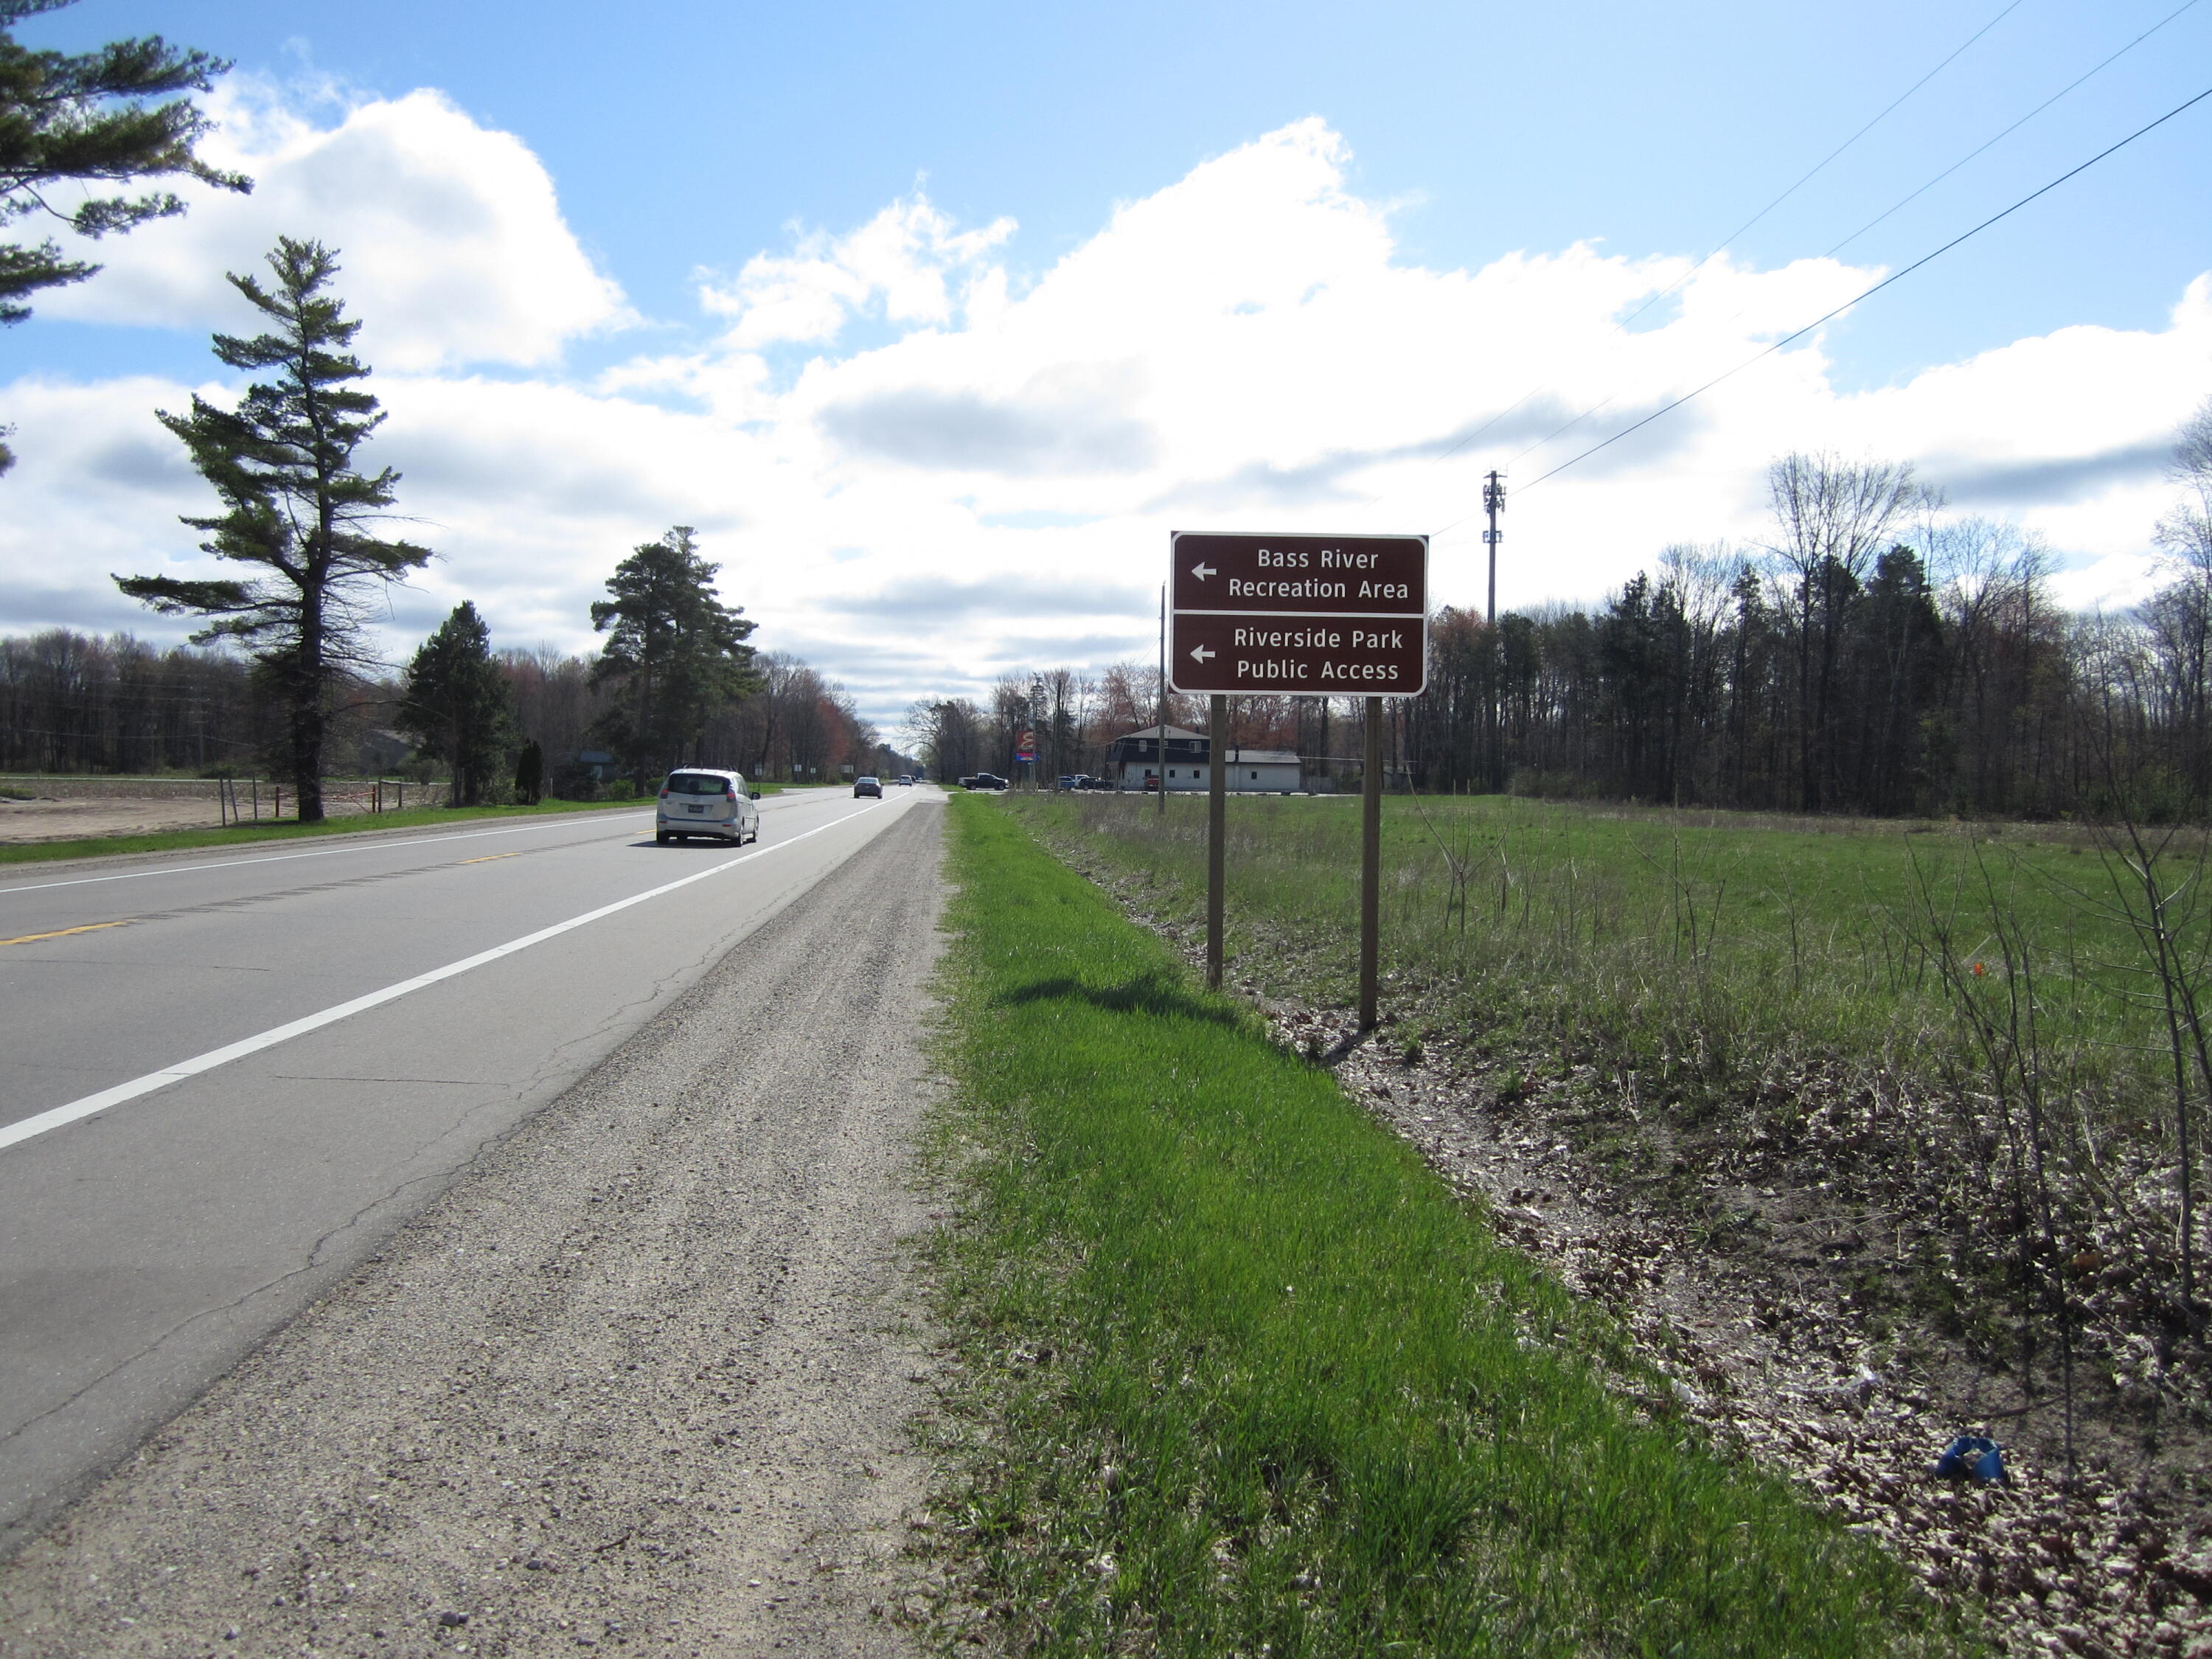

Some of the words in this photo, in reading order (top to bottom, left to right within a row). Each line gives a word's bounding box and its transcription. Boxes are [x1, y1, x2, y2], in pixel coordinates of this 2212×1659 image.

[1259, 549, 1308, 567] Bass
[1322, 549, 1378, 568] River
[1230, 578, 1345, 597] Recreation
[1359, 581, 1408, 598] Area
[1235, 627, 1340, 647] Riverside
[1353, 630, 1402, 648] Park
[1238, 660, 1307, 678] Public
[1321, 661, 1397, 679] Access
